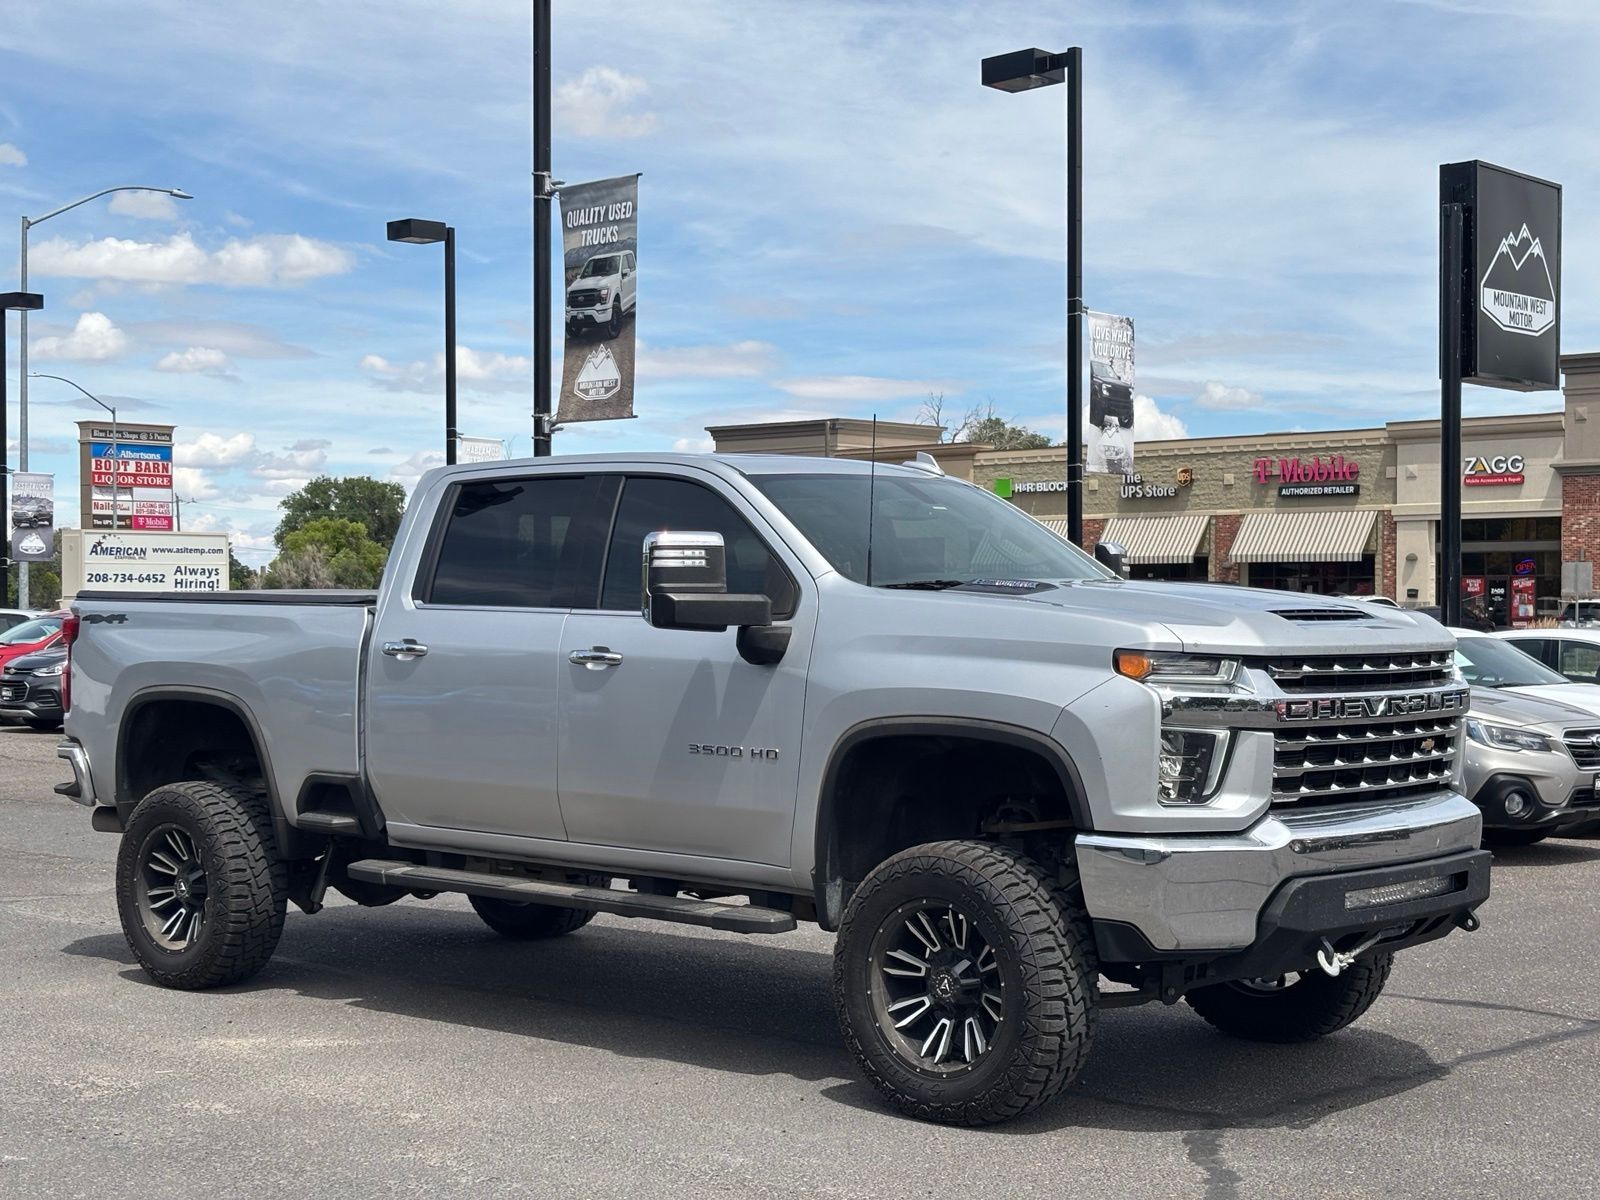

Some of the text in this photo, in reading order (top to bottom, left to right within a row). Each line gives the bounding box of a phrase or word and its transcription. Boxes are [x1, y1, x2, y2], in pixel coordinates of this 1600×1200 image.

[567, 201, 633, 228] QUALITY USED
[581, 225, 619, 246] TRUCKS
[1493, 290, 1547, 315] MOUNTAIN WEST
[1508, 311, 1533, 328] MOTOR
[1111, 328, 1132, 343] WHAT
[1094, 341, 1132, 360] YOU DRIVE
[107, 430, 121, 438] Laes
[120, 450, 161, 460] Albertsons
[135, 461, 170, 474] BARN
[1464, 455, 1524, 474] ZAGG
[136, 476, 170, 485] STORE
[1121, 485, 1176, 499] UPS Store
[1281, 486, 1354, 496] AUTHORIZED RETAILER
[89, 543, 224, 557] AMERICAN www.asitemp.com
[87, 573, 166, 583] 208-734-6452
[174, 565, 220, 579] Always
[174, 578, 220, 591] Hiring!
[1280, 689, 1469, 722] CHEVROLET
[688, 743, 779, 760] 3500 HD
